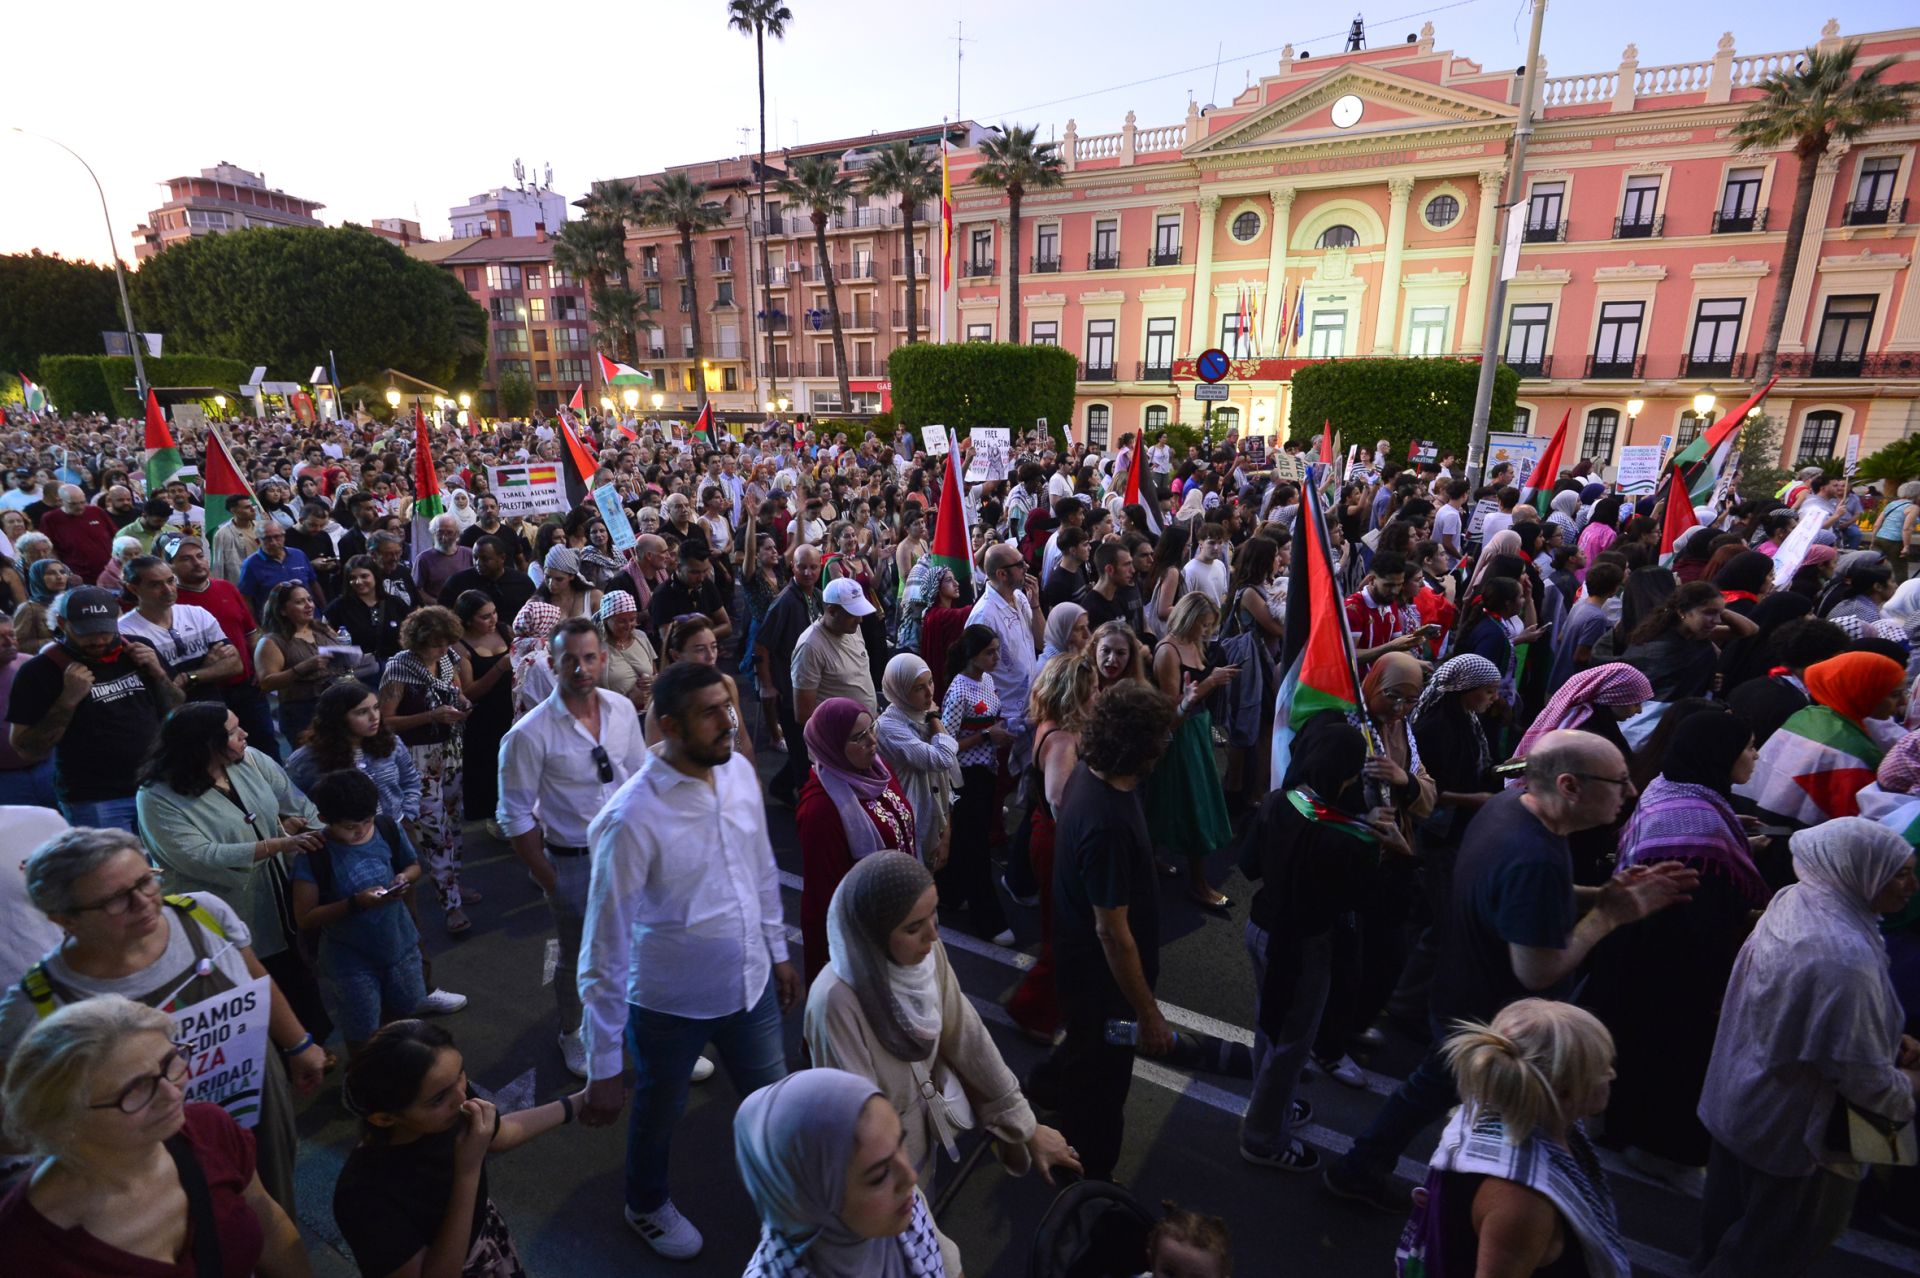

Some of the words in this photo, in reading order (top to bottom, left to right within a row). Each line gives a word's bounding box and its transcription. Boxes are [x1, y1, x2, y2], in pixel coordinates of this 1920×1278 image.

[984, 429, 998, 438] FREE
[502, 491, 526, 499] ISRAEL
[530, 489, 557, 497] ASESINA
[499, 500, 534, 510] PALESTINA
[81, 604, 109, 614] FILA
[176, 991, 257, 1041] PAMOS
[238, 1023, 247, 1035] a
